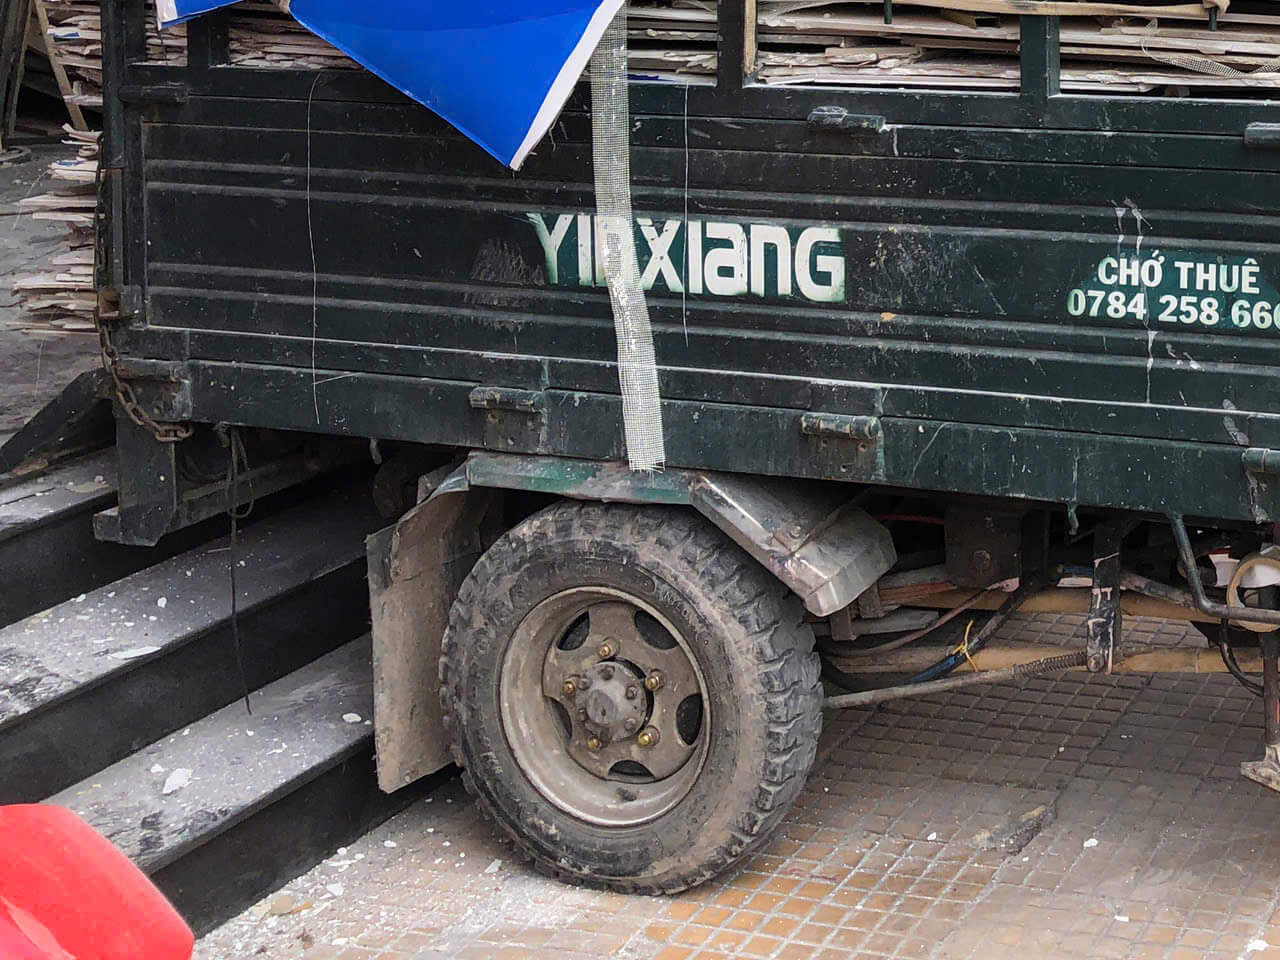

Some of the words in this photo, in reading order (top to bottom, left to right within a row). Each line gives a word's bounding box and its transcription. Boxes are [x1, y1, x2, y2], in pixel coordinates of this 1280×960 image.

[1174, 257, 1260, 295] THUÊ
[1066, 288, 1147, 321] 0784
[1157, 294, 1220, 326] 258
